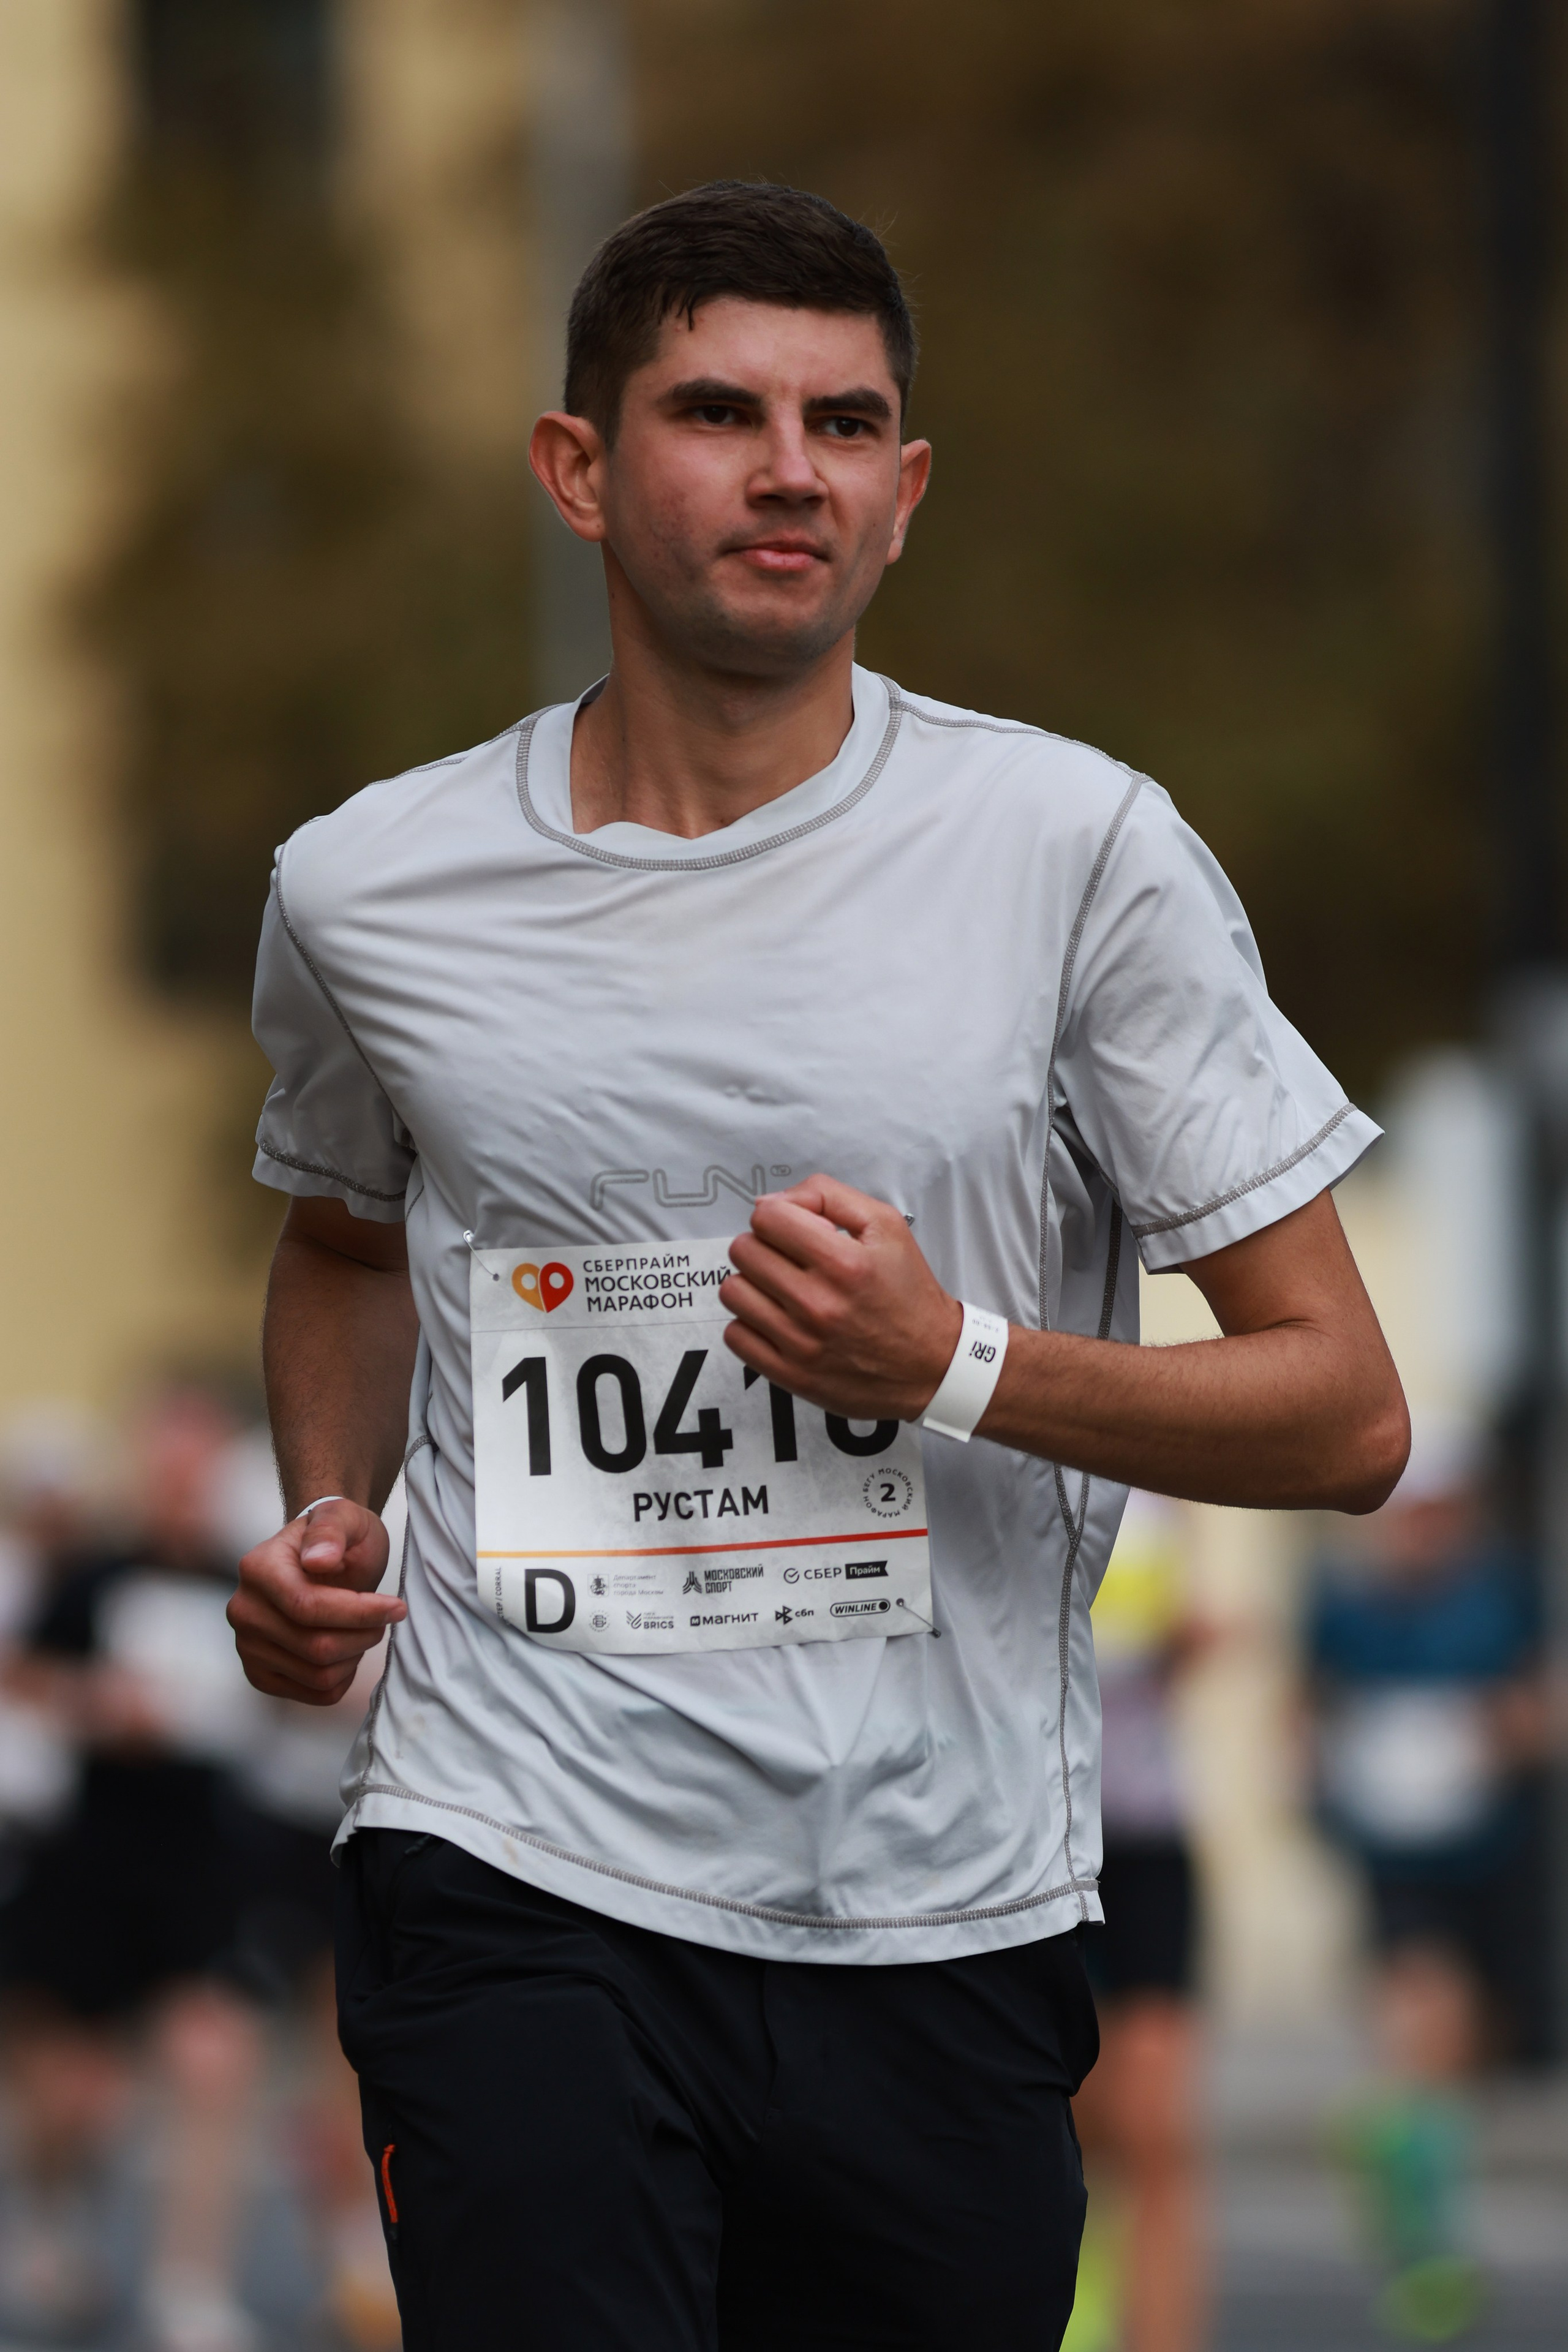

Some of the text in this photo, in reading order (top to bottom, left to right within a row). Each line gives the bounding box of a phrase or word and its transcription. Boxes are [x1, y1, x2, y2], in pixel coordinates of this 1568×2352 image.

[583, 1254, 690, 1272] СБЕРПРАЙМ
[584, 1265, 731, 1292] МОСКОВСКИЙ
[587, 1292, 693, 1312] МАРАФОН
[878, 1468, 913, 1510] МОСКОВСКИЙ
[880, 1483, 895, 1502] 2
[633, 1485, 769, 1522] РУСТАМ
[863, 1496, 900, 1518] МАРАФОН
[704, 1564, 764, 1581] МОСКОВСКИЙ
[804, 1565, 880, 1580] СБЕР Прайм
[705, 1580, 733, 1594] СПОРТ
[525, 1569, 576, 1634] D
[835, 1602, 876, 1615] WINLINE
[703, 1611, 759, 1626] магнит
[795, 1608, 814, 1618] сбп
[644, 1621, 674, 1629] BRICS
